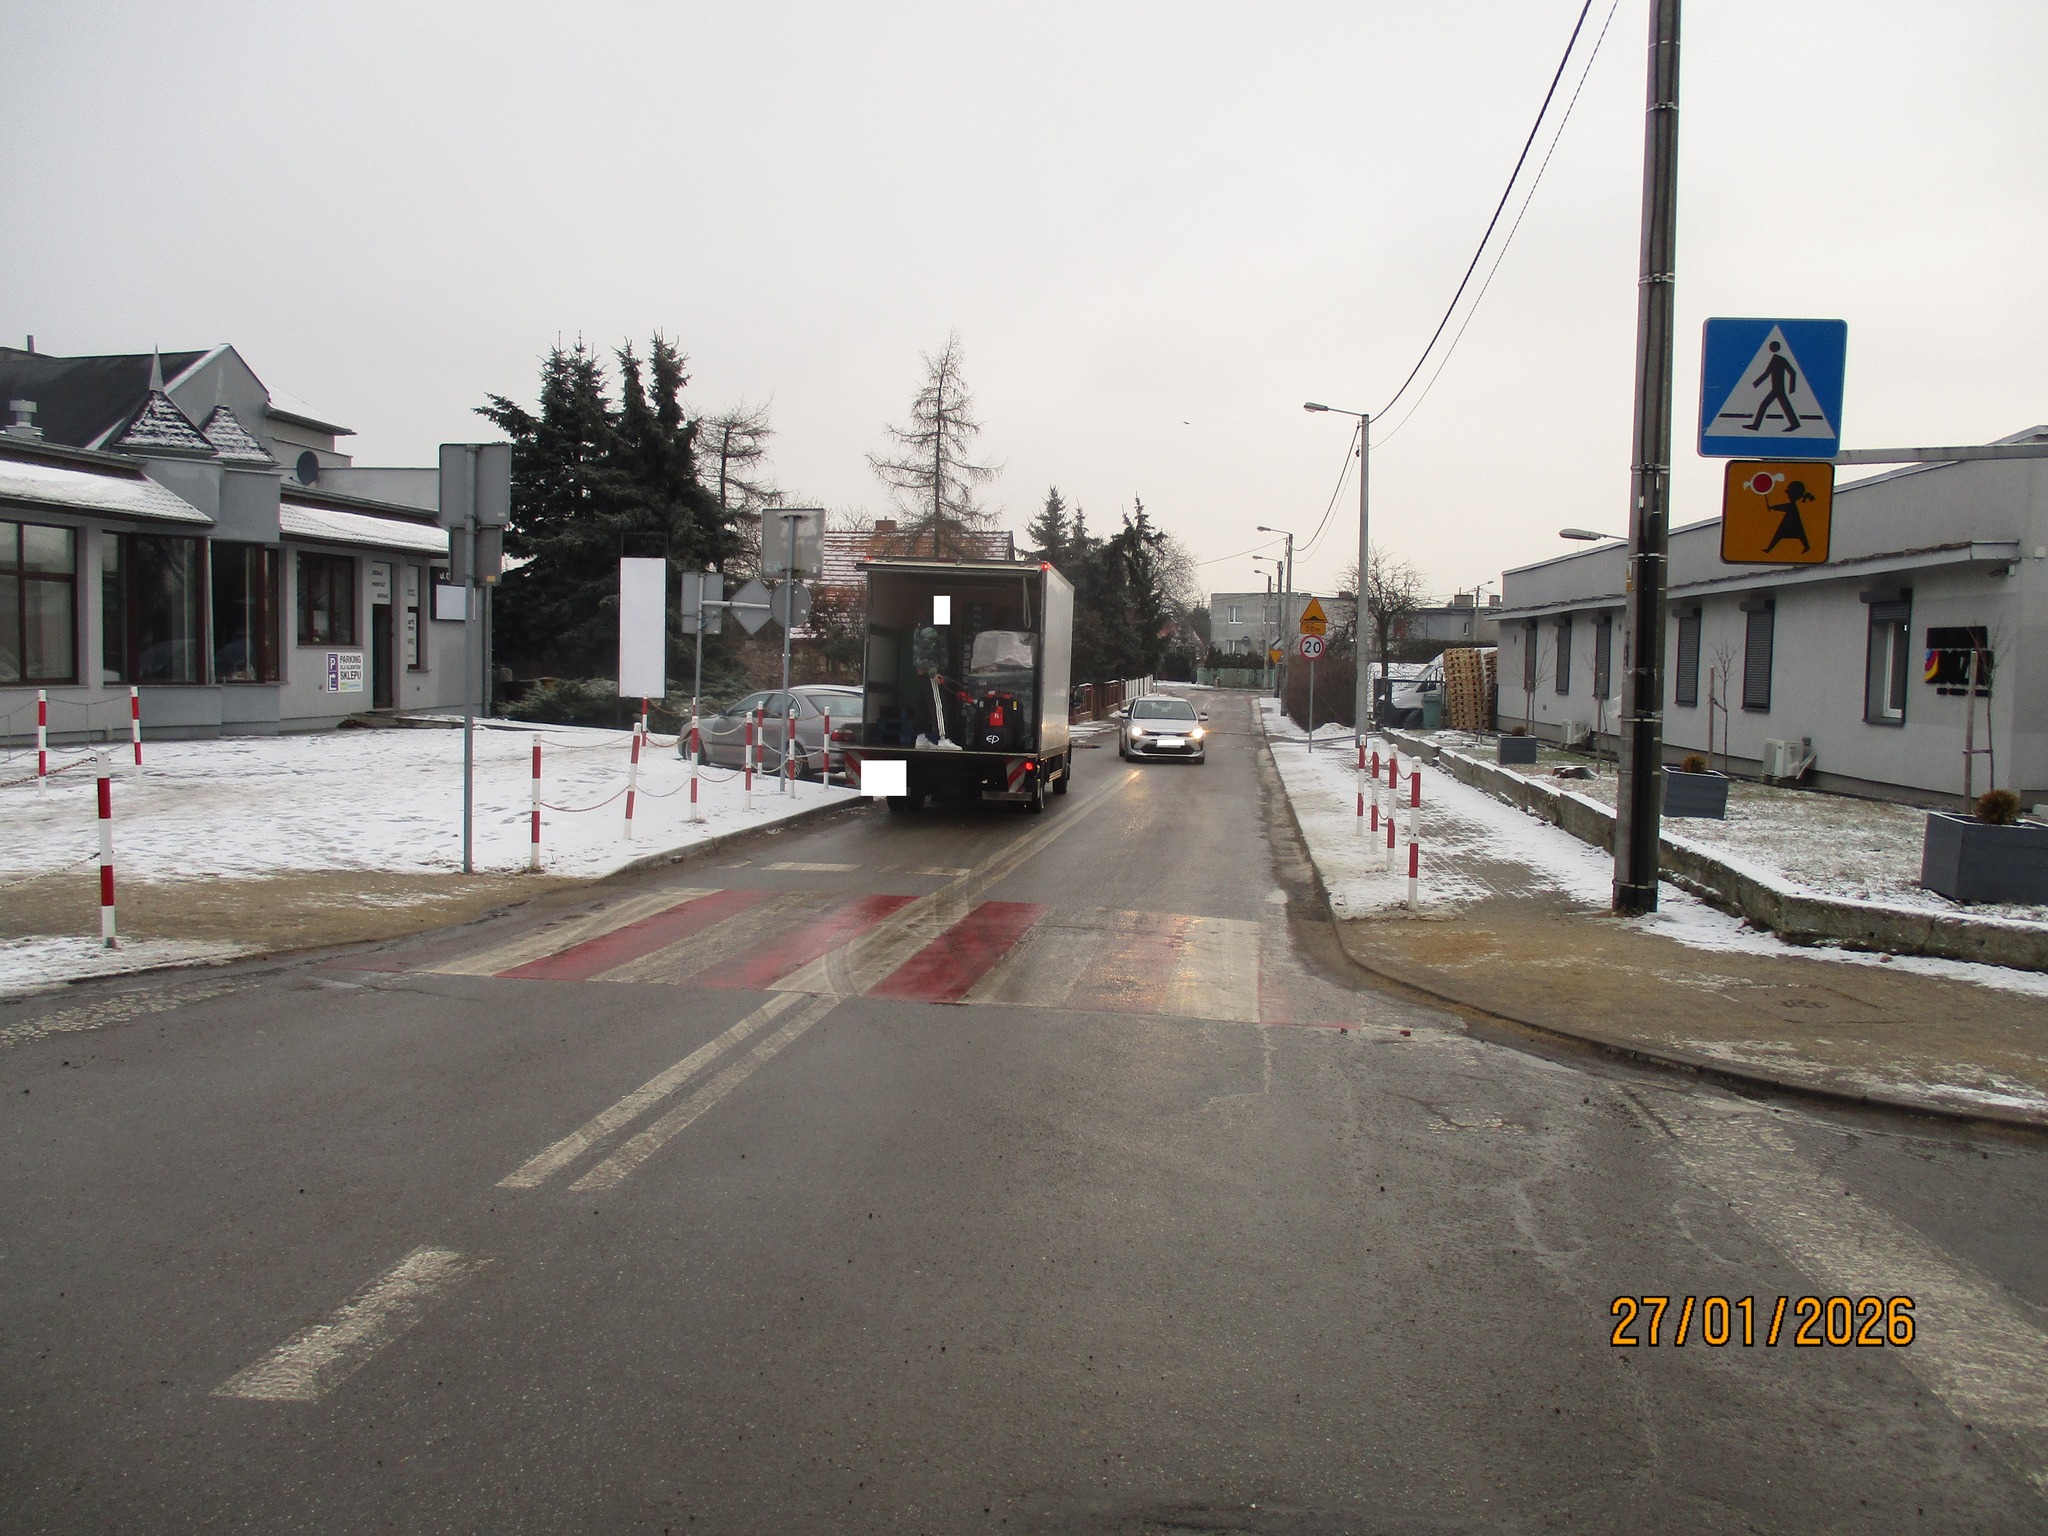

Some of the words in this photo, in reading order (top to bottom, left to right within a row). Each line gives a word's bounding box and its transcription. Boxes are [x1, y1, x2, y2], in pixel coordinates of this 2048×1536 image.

[1304, 641, 1321, 653] 20
[330, 657, 336, 670] P
[340, 655, 361, 664] PARKING
[340, 671, 361, 680] SKLEPU
